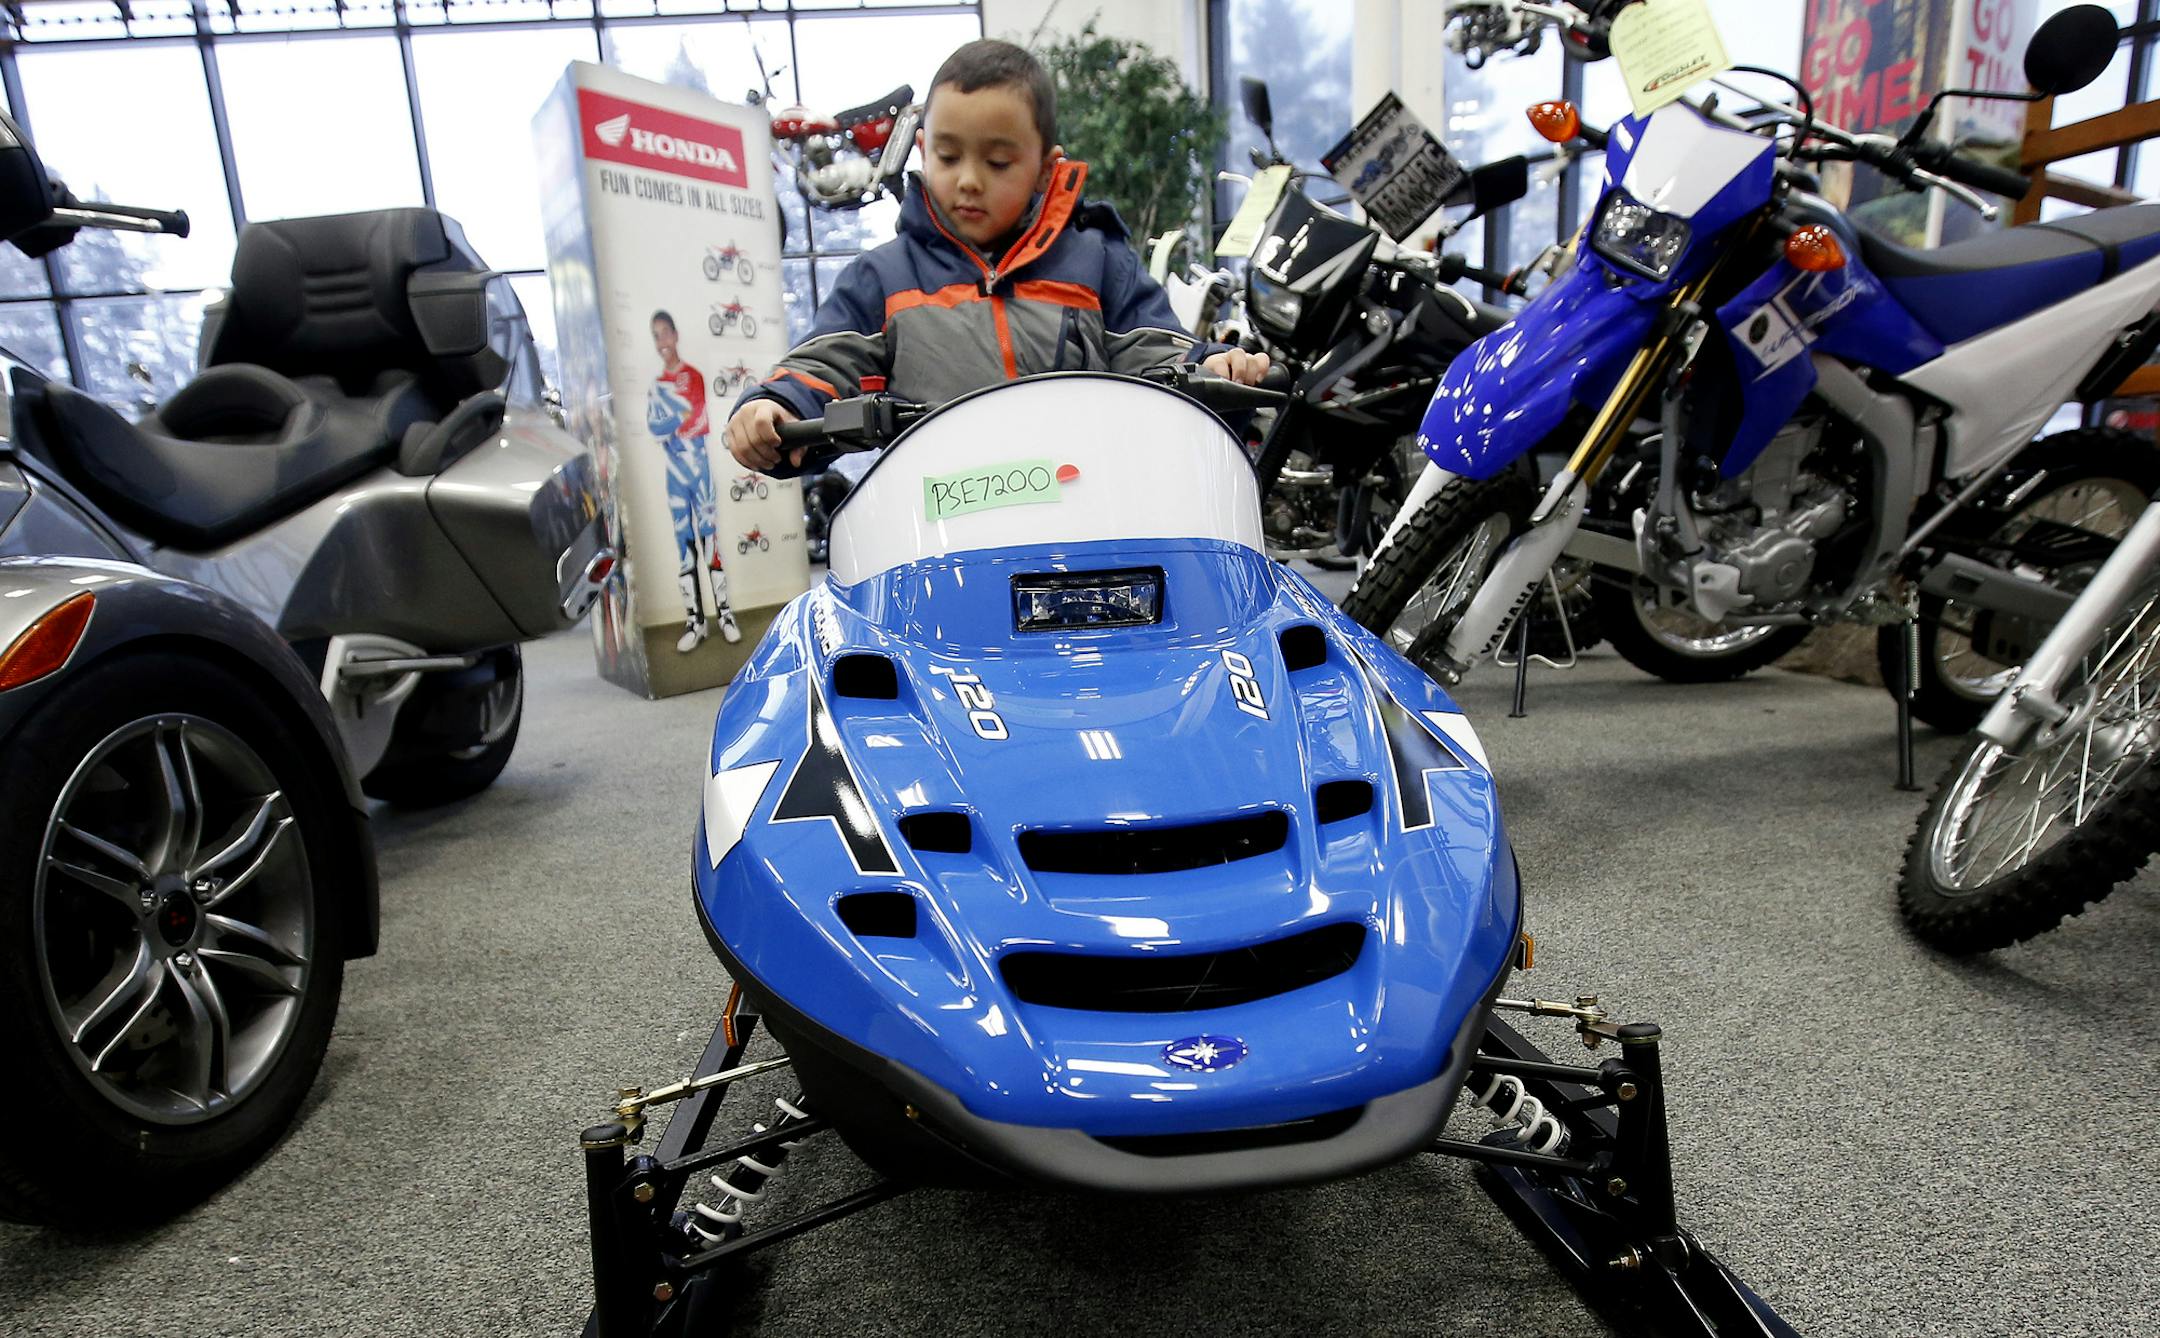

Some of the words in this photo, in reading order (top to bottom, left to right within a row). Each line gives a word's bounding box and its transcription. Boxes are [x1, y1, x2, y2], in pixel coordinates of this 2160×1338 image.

[1802, 18, 1872, 92] GO
[1972, 0, 2015, 52] GO
[630, 127, 737, 173] HONDA
[1365, 141, 1447, 219] TERRIFIC
[600, 169, 630, 194] FUN
[634, 176, 683, 204] COMES
[687, 184, 701, 208] IN
[705, 189, 727, 212] ALL
[931, 466, 1051, 515] PSE7200
[1480, 581, 1540, 654] YAMAHA
[948, 673, 1010, 741] 120
[1220, 649, 1271, 721] 120
